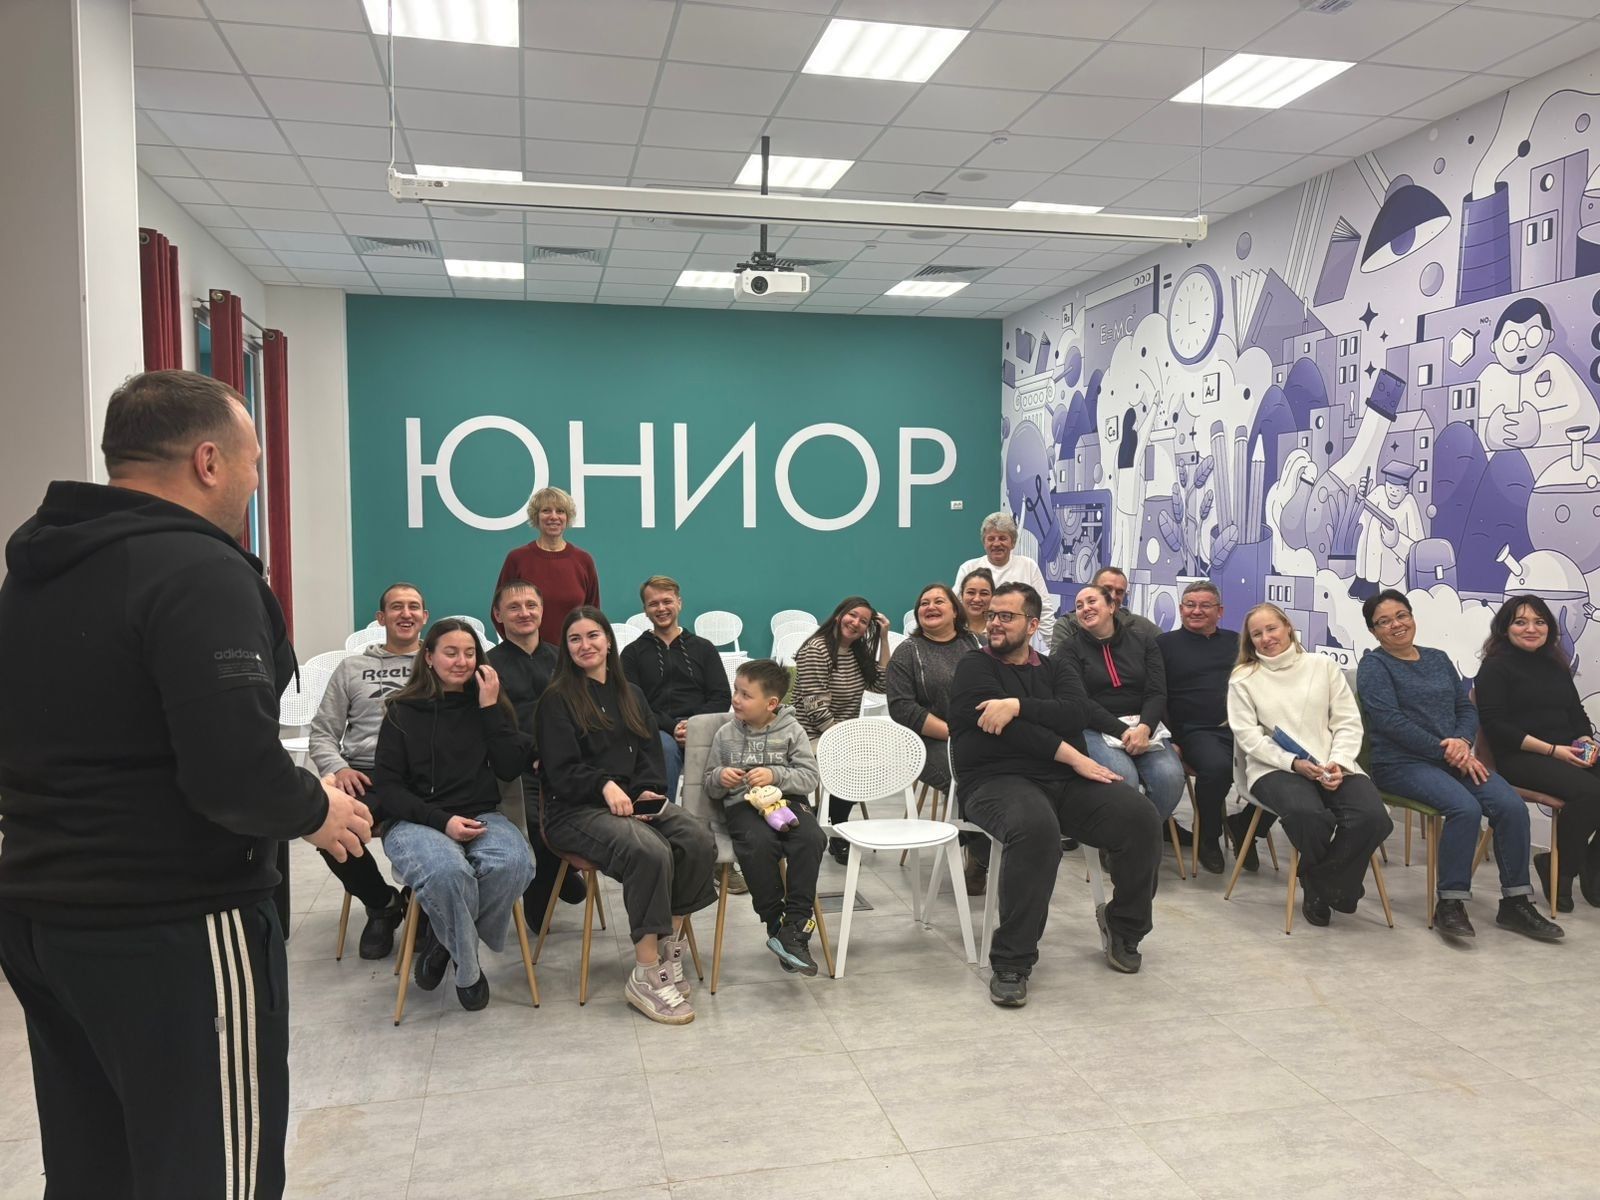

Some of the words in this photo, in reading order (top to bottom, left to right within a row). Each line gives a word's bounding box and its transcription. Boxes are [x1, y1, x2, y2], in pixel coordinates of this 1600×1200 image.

[1205, 385, 1215, 397] Ar
[404, 414, 958, 531] ЮНИОР
[214, 648, 257, 660] adidas
[362, 666, 412, 681] Reeb
[748, 740, 765, 752] NO
